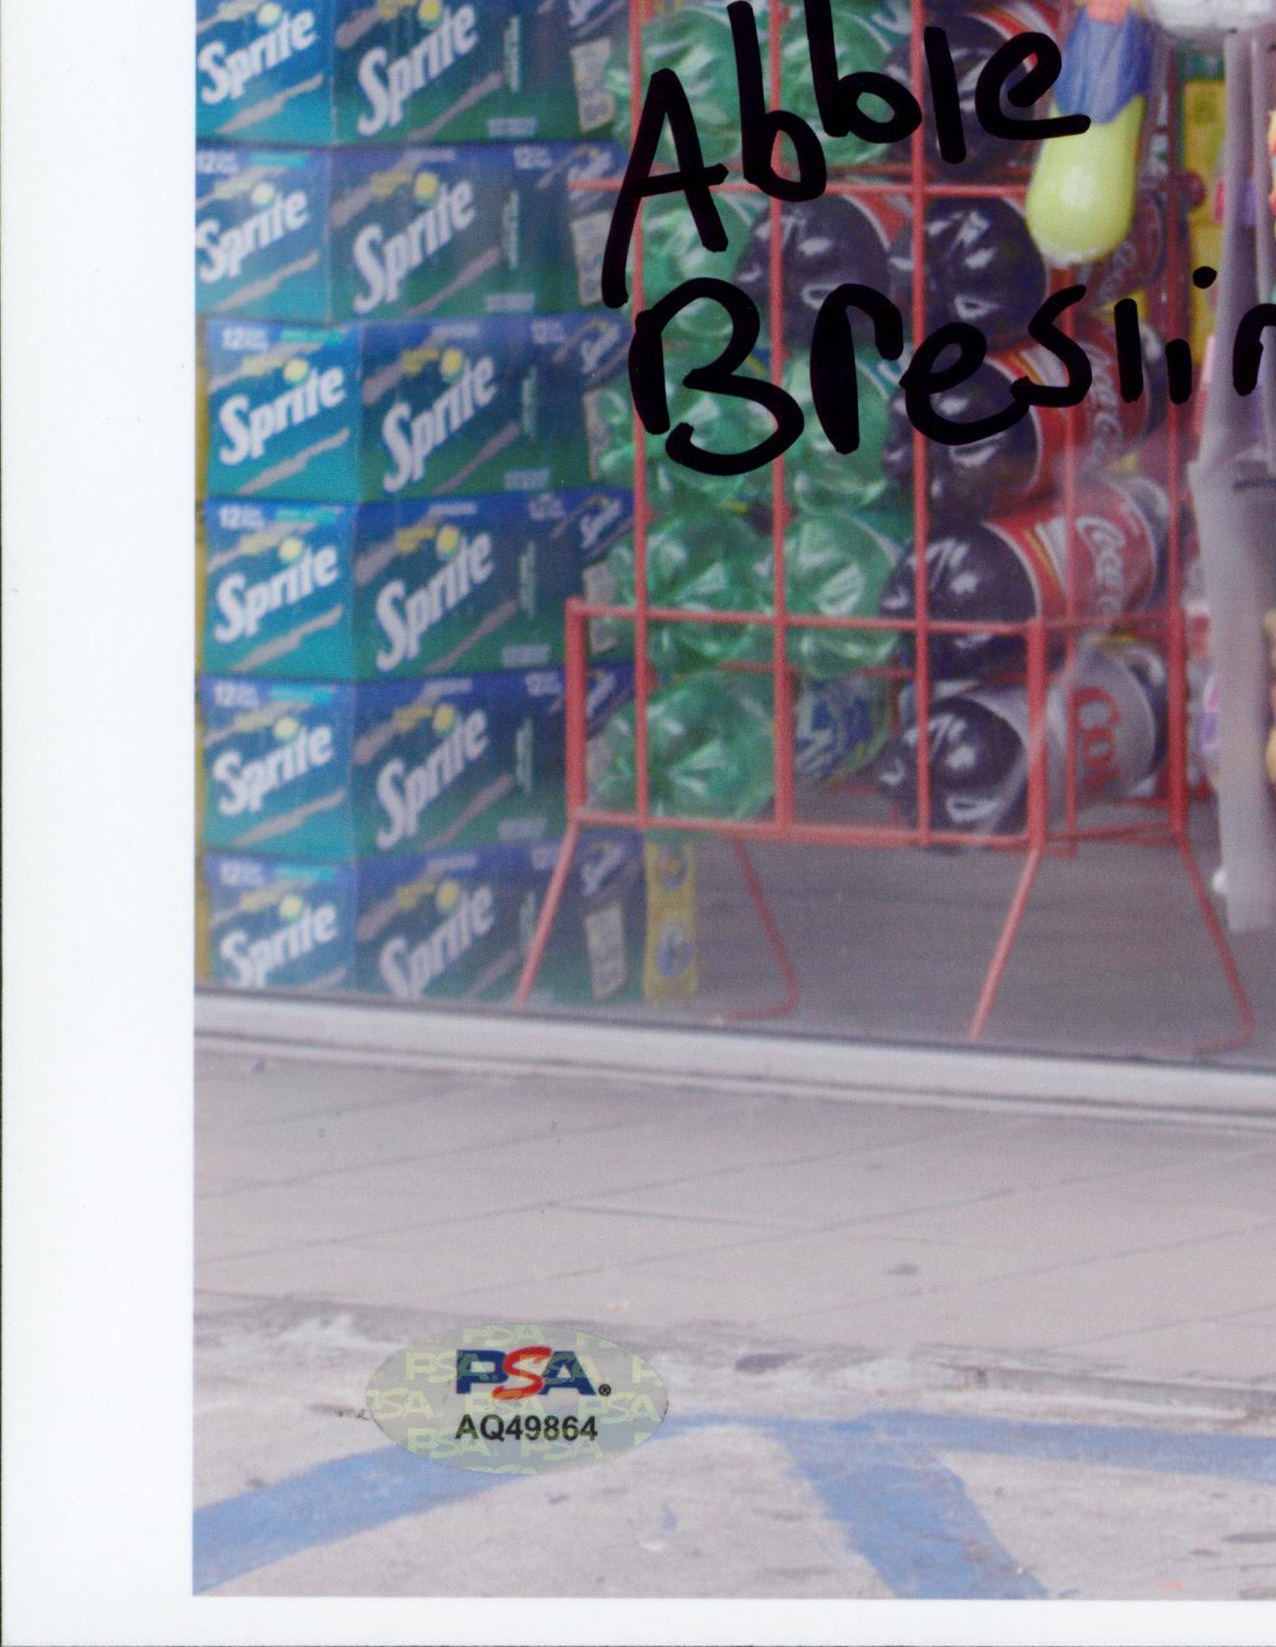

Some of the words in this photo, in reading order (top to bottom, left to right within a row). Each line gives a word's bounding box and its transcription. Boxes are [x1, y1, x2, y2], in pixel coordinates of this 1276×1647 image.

[199, 9, 318, 106] Sprite
[356, 3, 479, 137] Sprite
[196, 189, 309, 284] Sprite
[353, 179, 477, 314] Sprite
[219, 365, 347, 467] Sprite
[382, 355, 497, 494] Sprite
[214, 544, 341, 644] Sprite
[376, 531, 495, 672] Sprite
[212, 724, 335, 817] Sprite
[376, 709, 491, 850] Sprite
[220, 904, 338, 989] Sprite
